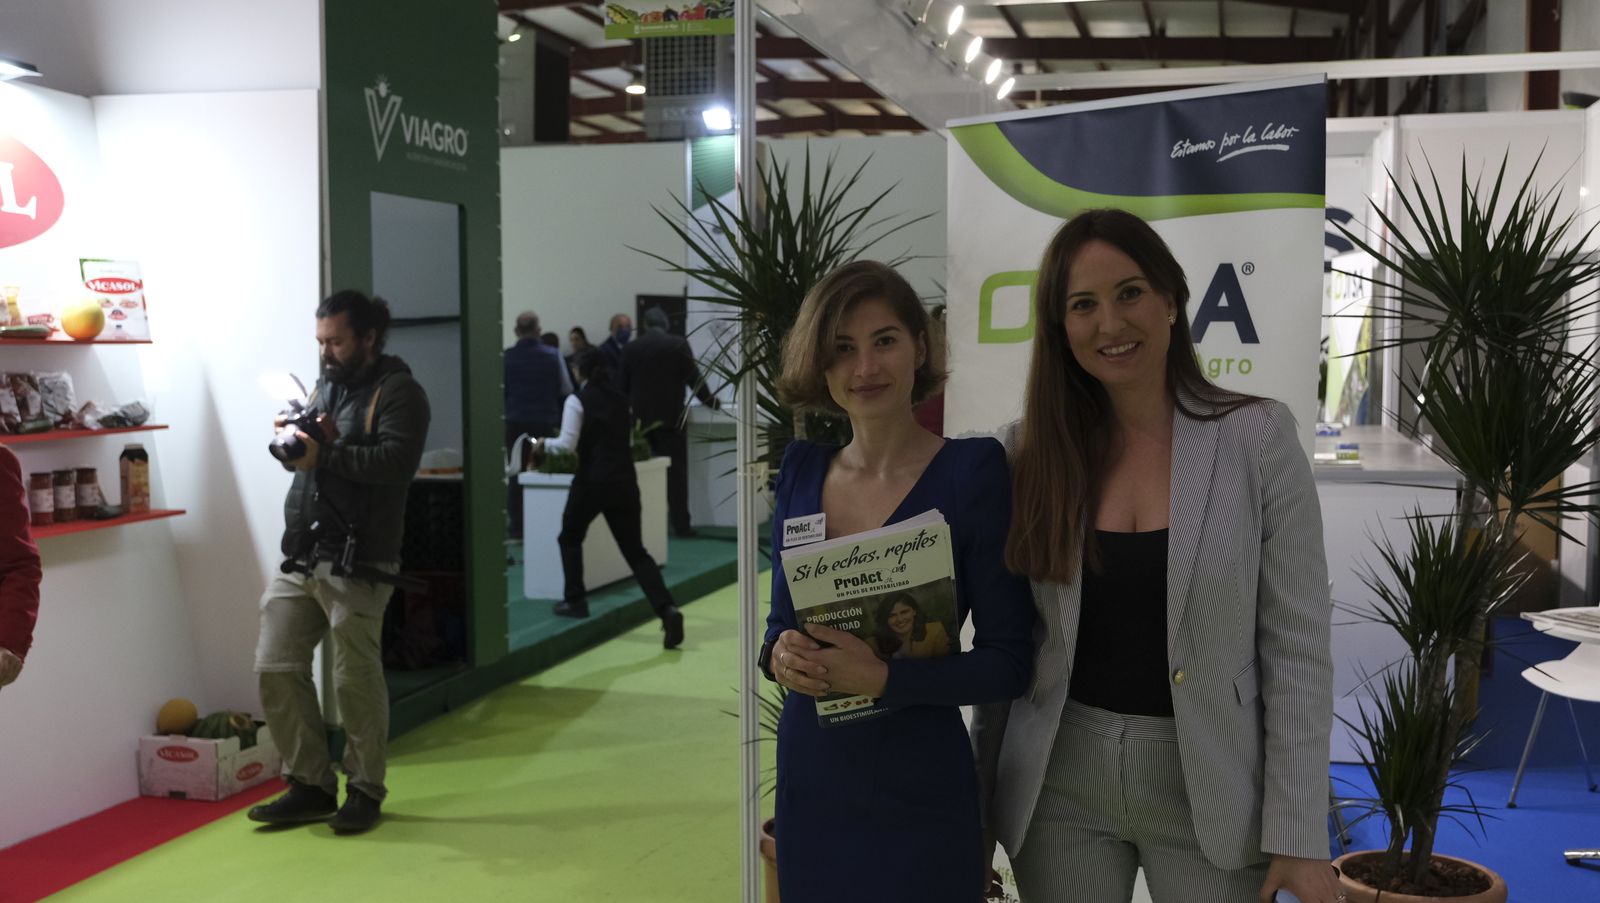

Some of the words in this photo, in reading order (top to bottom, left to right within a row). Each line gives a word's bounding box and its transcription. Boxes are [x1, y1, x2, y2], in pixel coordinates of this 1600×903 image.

[400, 113, 467, 156] VIAGRO
[1170, 138, 1216, 159] Estamos
[1219, 132, 1241, 155] por
[1242, 126, 1257, 144] la
[786, 522, 811, 535] ProAct
[793, 564, 812, 582] Si
[814, 556, 828, 578] lo
[884, 529, 938, 565] repites
[833, 570, 883, 590] ProAct
[869, 580, 910, 592] RENTABILIDAD
[806, 607, 863, 624] PRODUCCIÓN
